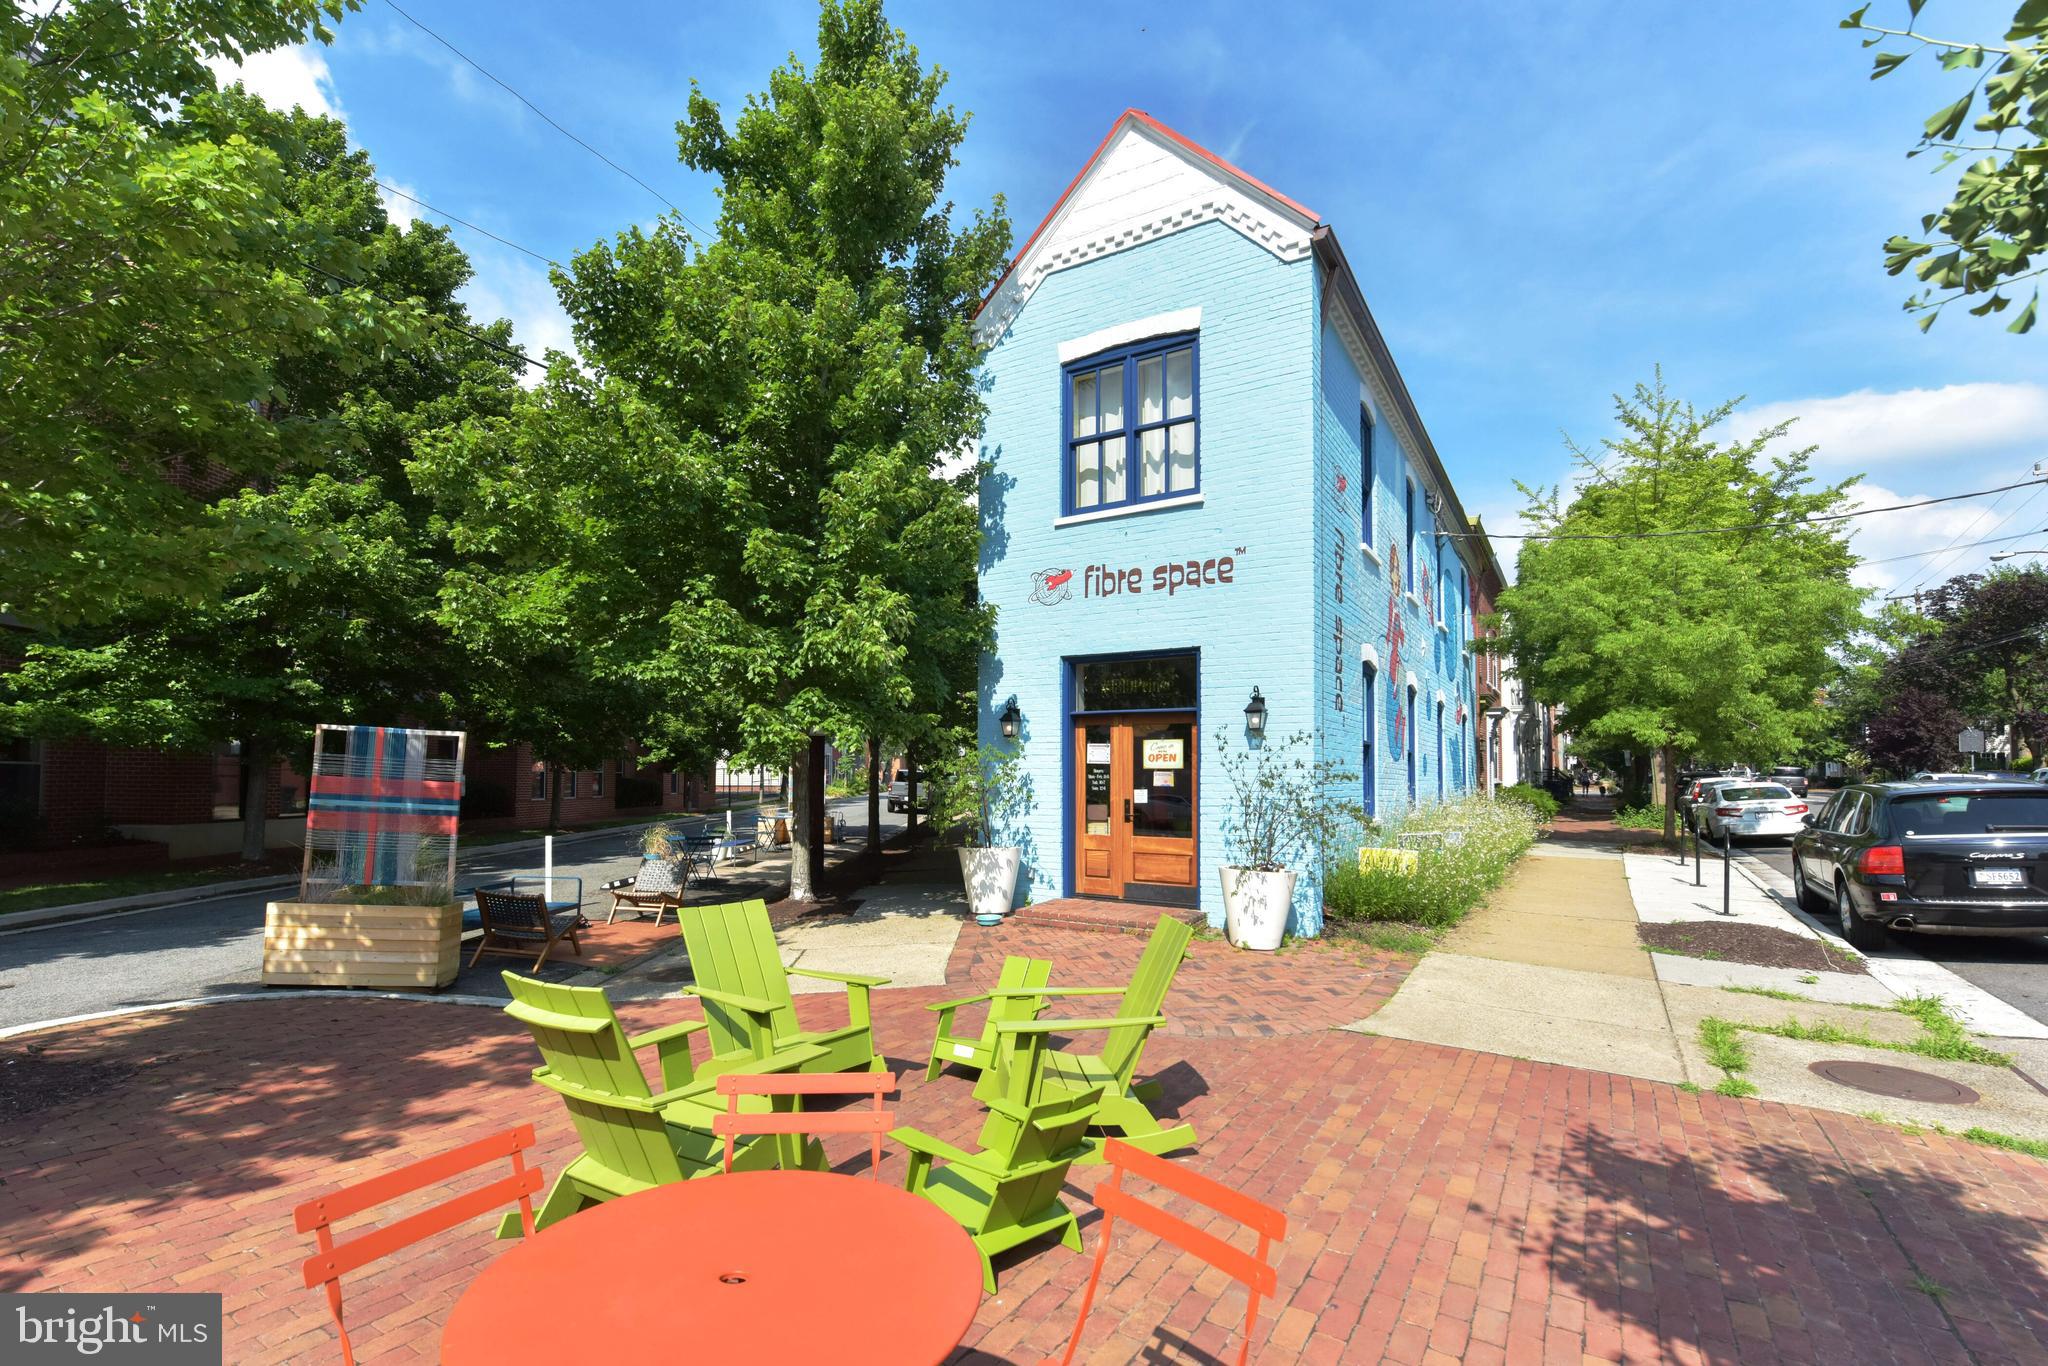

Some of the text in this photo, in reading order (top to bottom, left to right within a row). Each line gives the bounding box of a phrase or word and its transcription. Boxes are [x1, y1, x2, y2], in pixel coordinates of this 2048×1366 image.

[1085, 564, 1143, 598] fibre
[1153, 556, 1234, 596] space
[1333, 614, 1344, 713] space
[1148, 753, 1177, 762] OPEN
[1969, 852, 2013, 860] Cayenne
